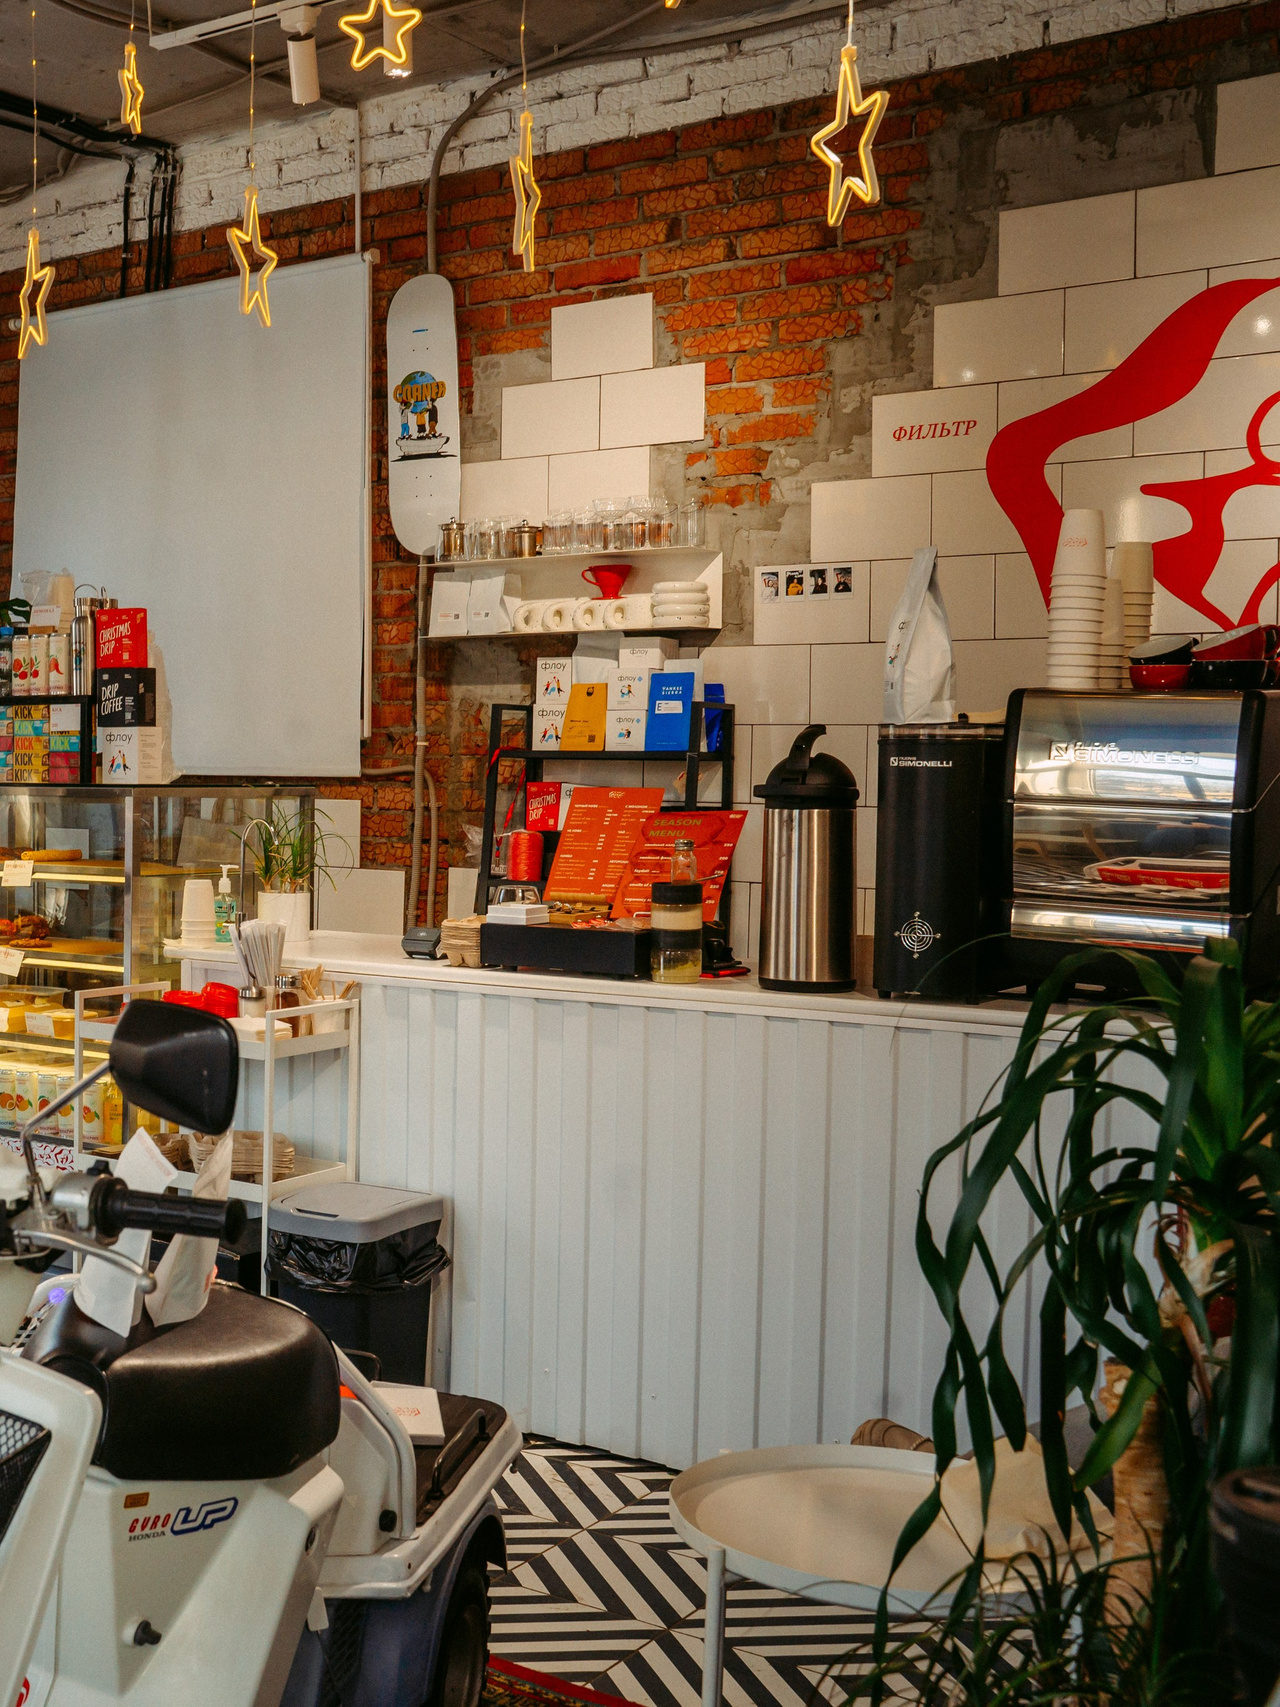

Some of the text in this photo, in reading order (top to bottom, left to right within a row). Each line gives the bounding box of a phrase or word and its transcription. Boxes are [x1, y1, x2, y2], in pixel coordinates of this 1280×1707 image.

[393, 381, 446, 403] CORNER
[892, 420, 977, 441] ФИЛЬТР
[99, 621, 131, 643] CHRISTMAS
[100, 641, 116, 657] DRIP
[541, 661, 566, 671] флоу
[102, 683, 119, 701] DRIP
[14, 705, 32, 719] KICK
[101, 696, 123, 715] COFFEE
[538, 708, 565, 718] флоу
[616, 717, 635, 725] флоу
[15, 737, 34, 751] KICK
[105, 732, 133, 744] флоу
[14, 753, 34, 766] KICK
[1075, 750, 1199, 765] SIMONELLI
[14, 768, 33, 782] KICK
[529, 793, 557, 810] CHRISTMAS
[529, 808, 543, 821] DRIP
[128, 1497, 239, 1536] GYRO UP
[128, 1530, 167, 1542] HONDA
